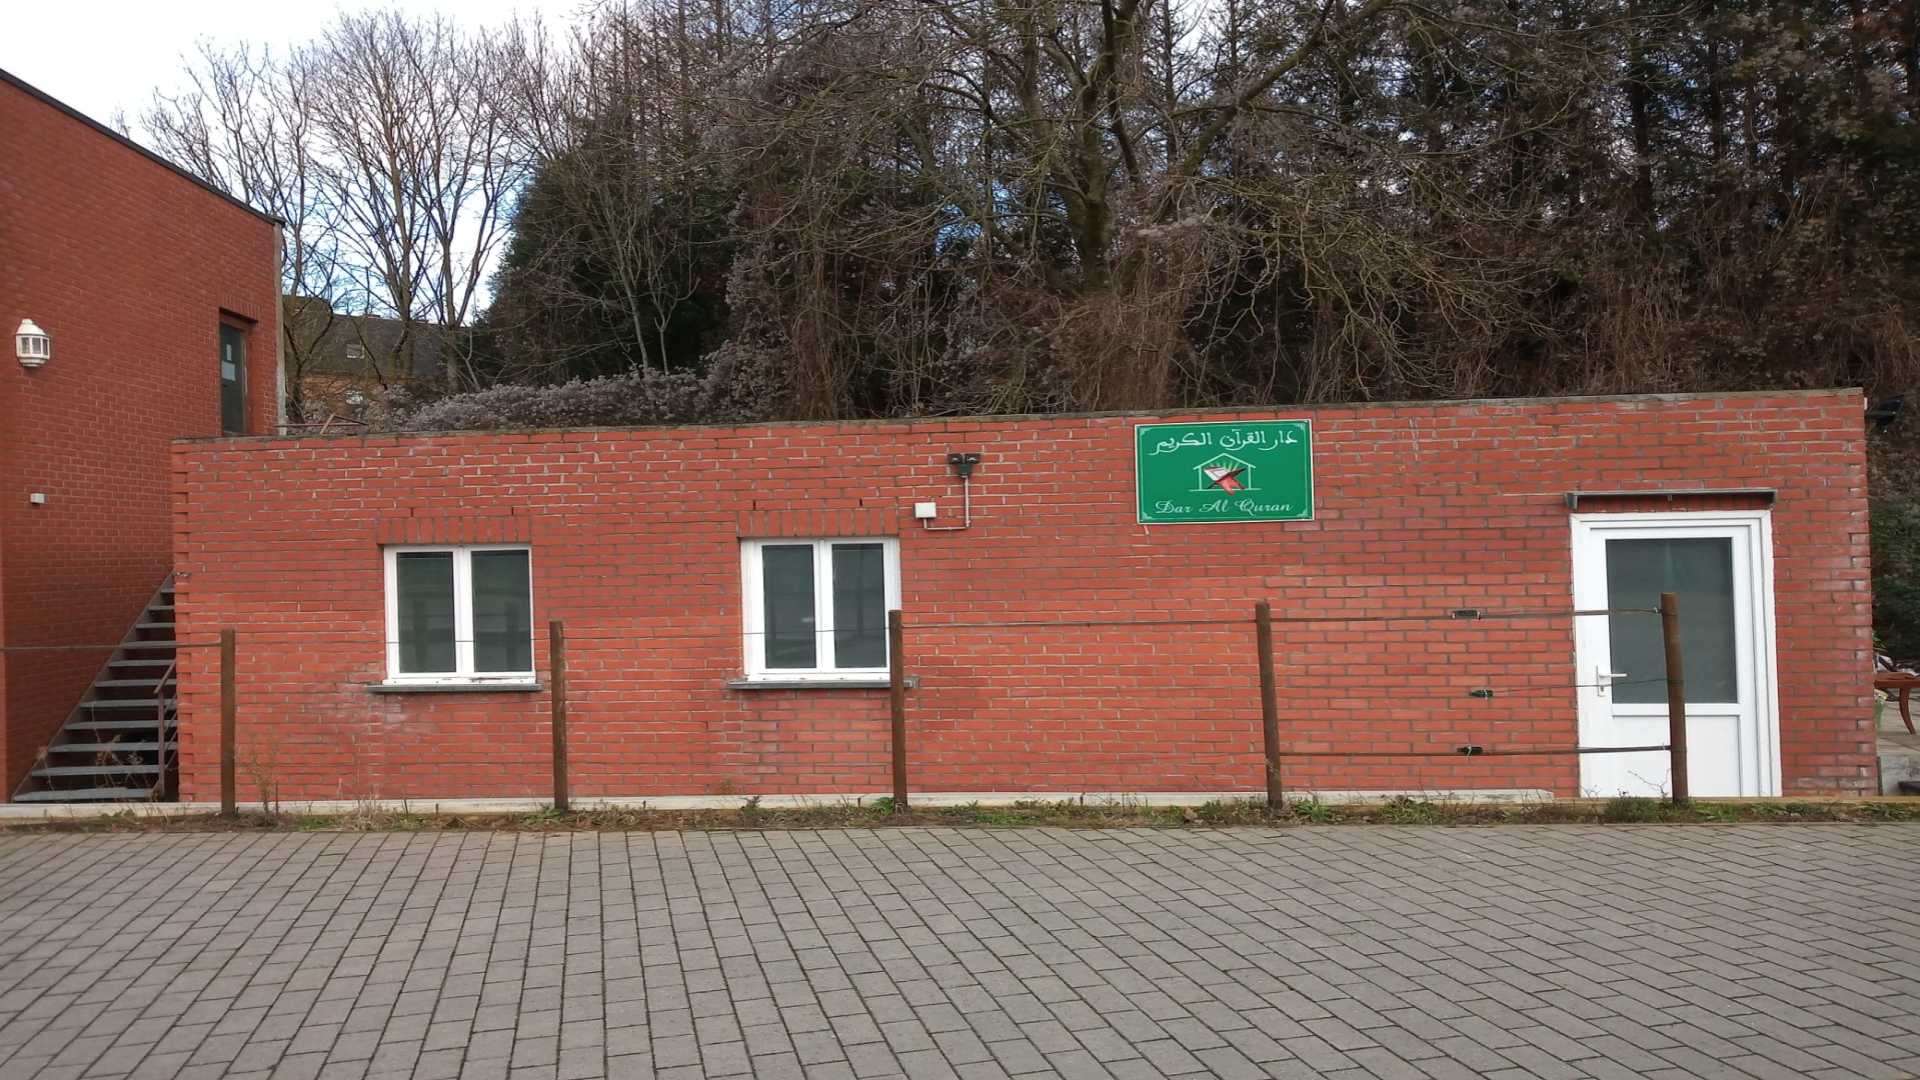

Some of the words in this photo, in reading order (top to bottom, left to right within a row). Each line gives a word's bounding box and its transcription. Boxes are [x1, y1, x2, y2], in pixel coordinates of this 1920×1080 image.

[1148, 432, 1212, 456] الكريم
[1220, 428, 1266, 451] القرآن
[1258, 430, 1298, 451] دار
[1155, 500, 1193, 514] Dar
[1199, 499, 1229, 513] Al
[1234, 498, 1293, 516] Quran
